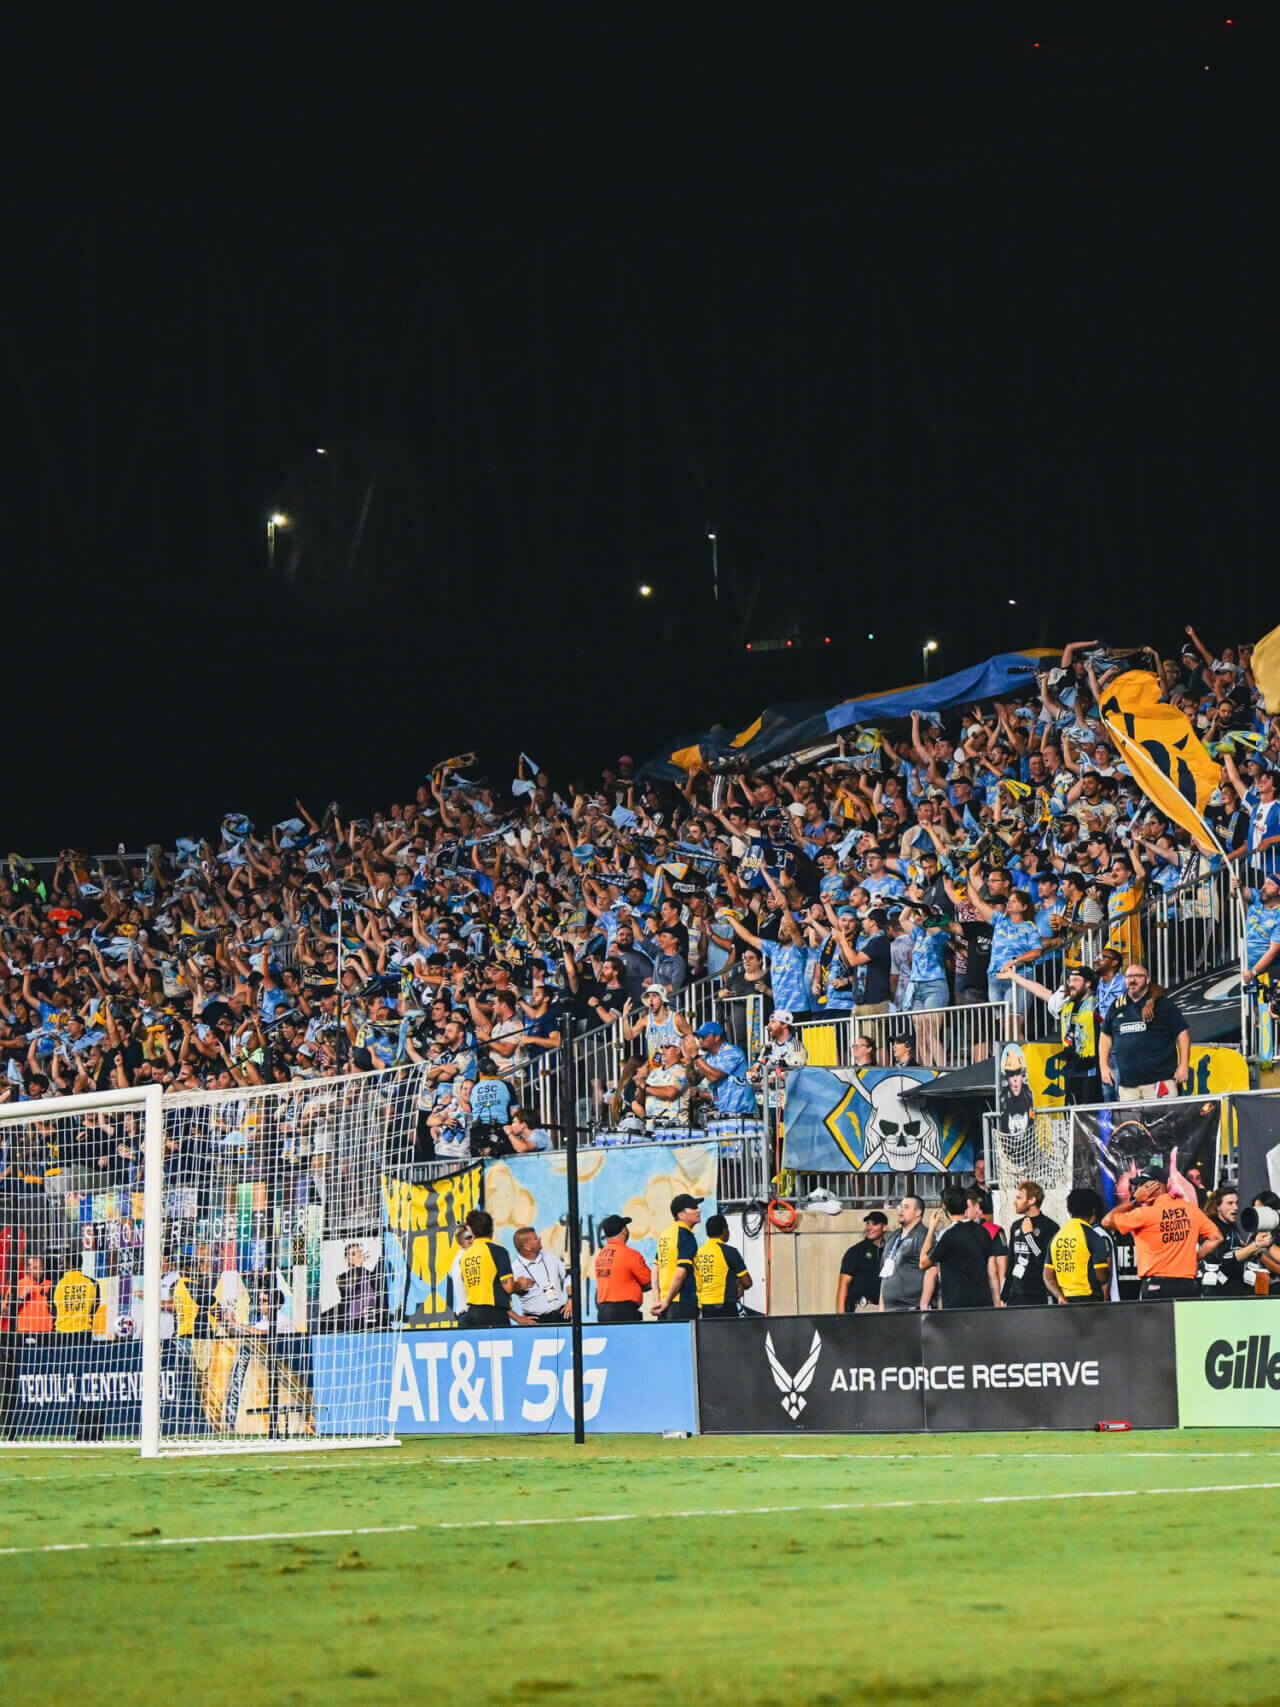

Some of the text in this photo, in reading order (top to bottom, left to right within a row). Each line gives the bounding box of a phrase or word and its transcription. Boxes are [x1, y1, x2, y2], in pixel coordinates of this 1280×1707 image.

[477, 1084, 498, 1095] CSC
[1162, 1207, 1188, 1221] APEX
[1159, 1219, 1192, 1232] SECURITY
[1056, 1237, 1077, 1249] CSC
[1161, 1230, 1190, 1244] GROUP
[464, 1255, 481, 1267] CSC
[1056, 1261, 1076, 1273] STAFF
[64, 1284, 87, 1295] CSC
[388, 1336, 609, 1423] AT&T 5G
[830, 1360, 1100, 1392] AIR FORCE RESERVE
[19, 1373, 76, 1407] TEQUILA
